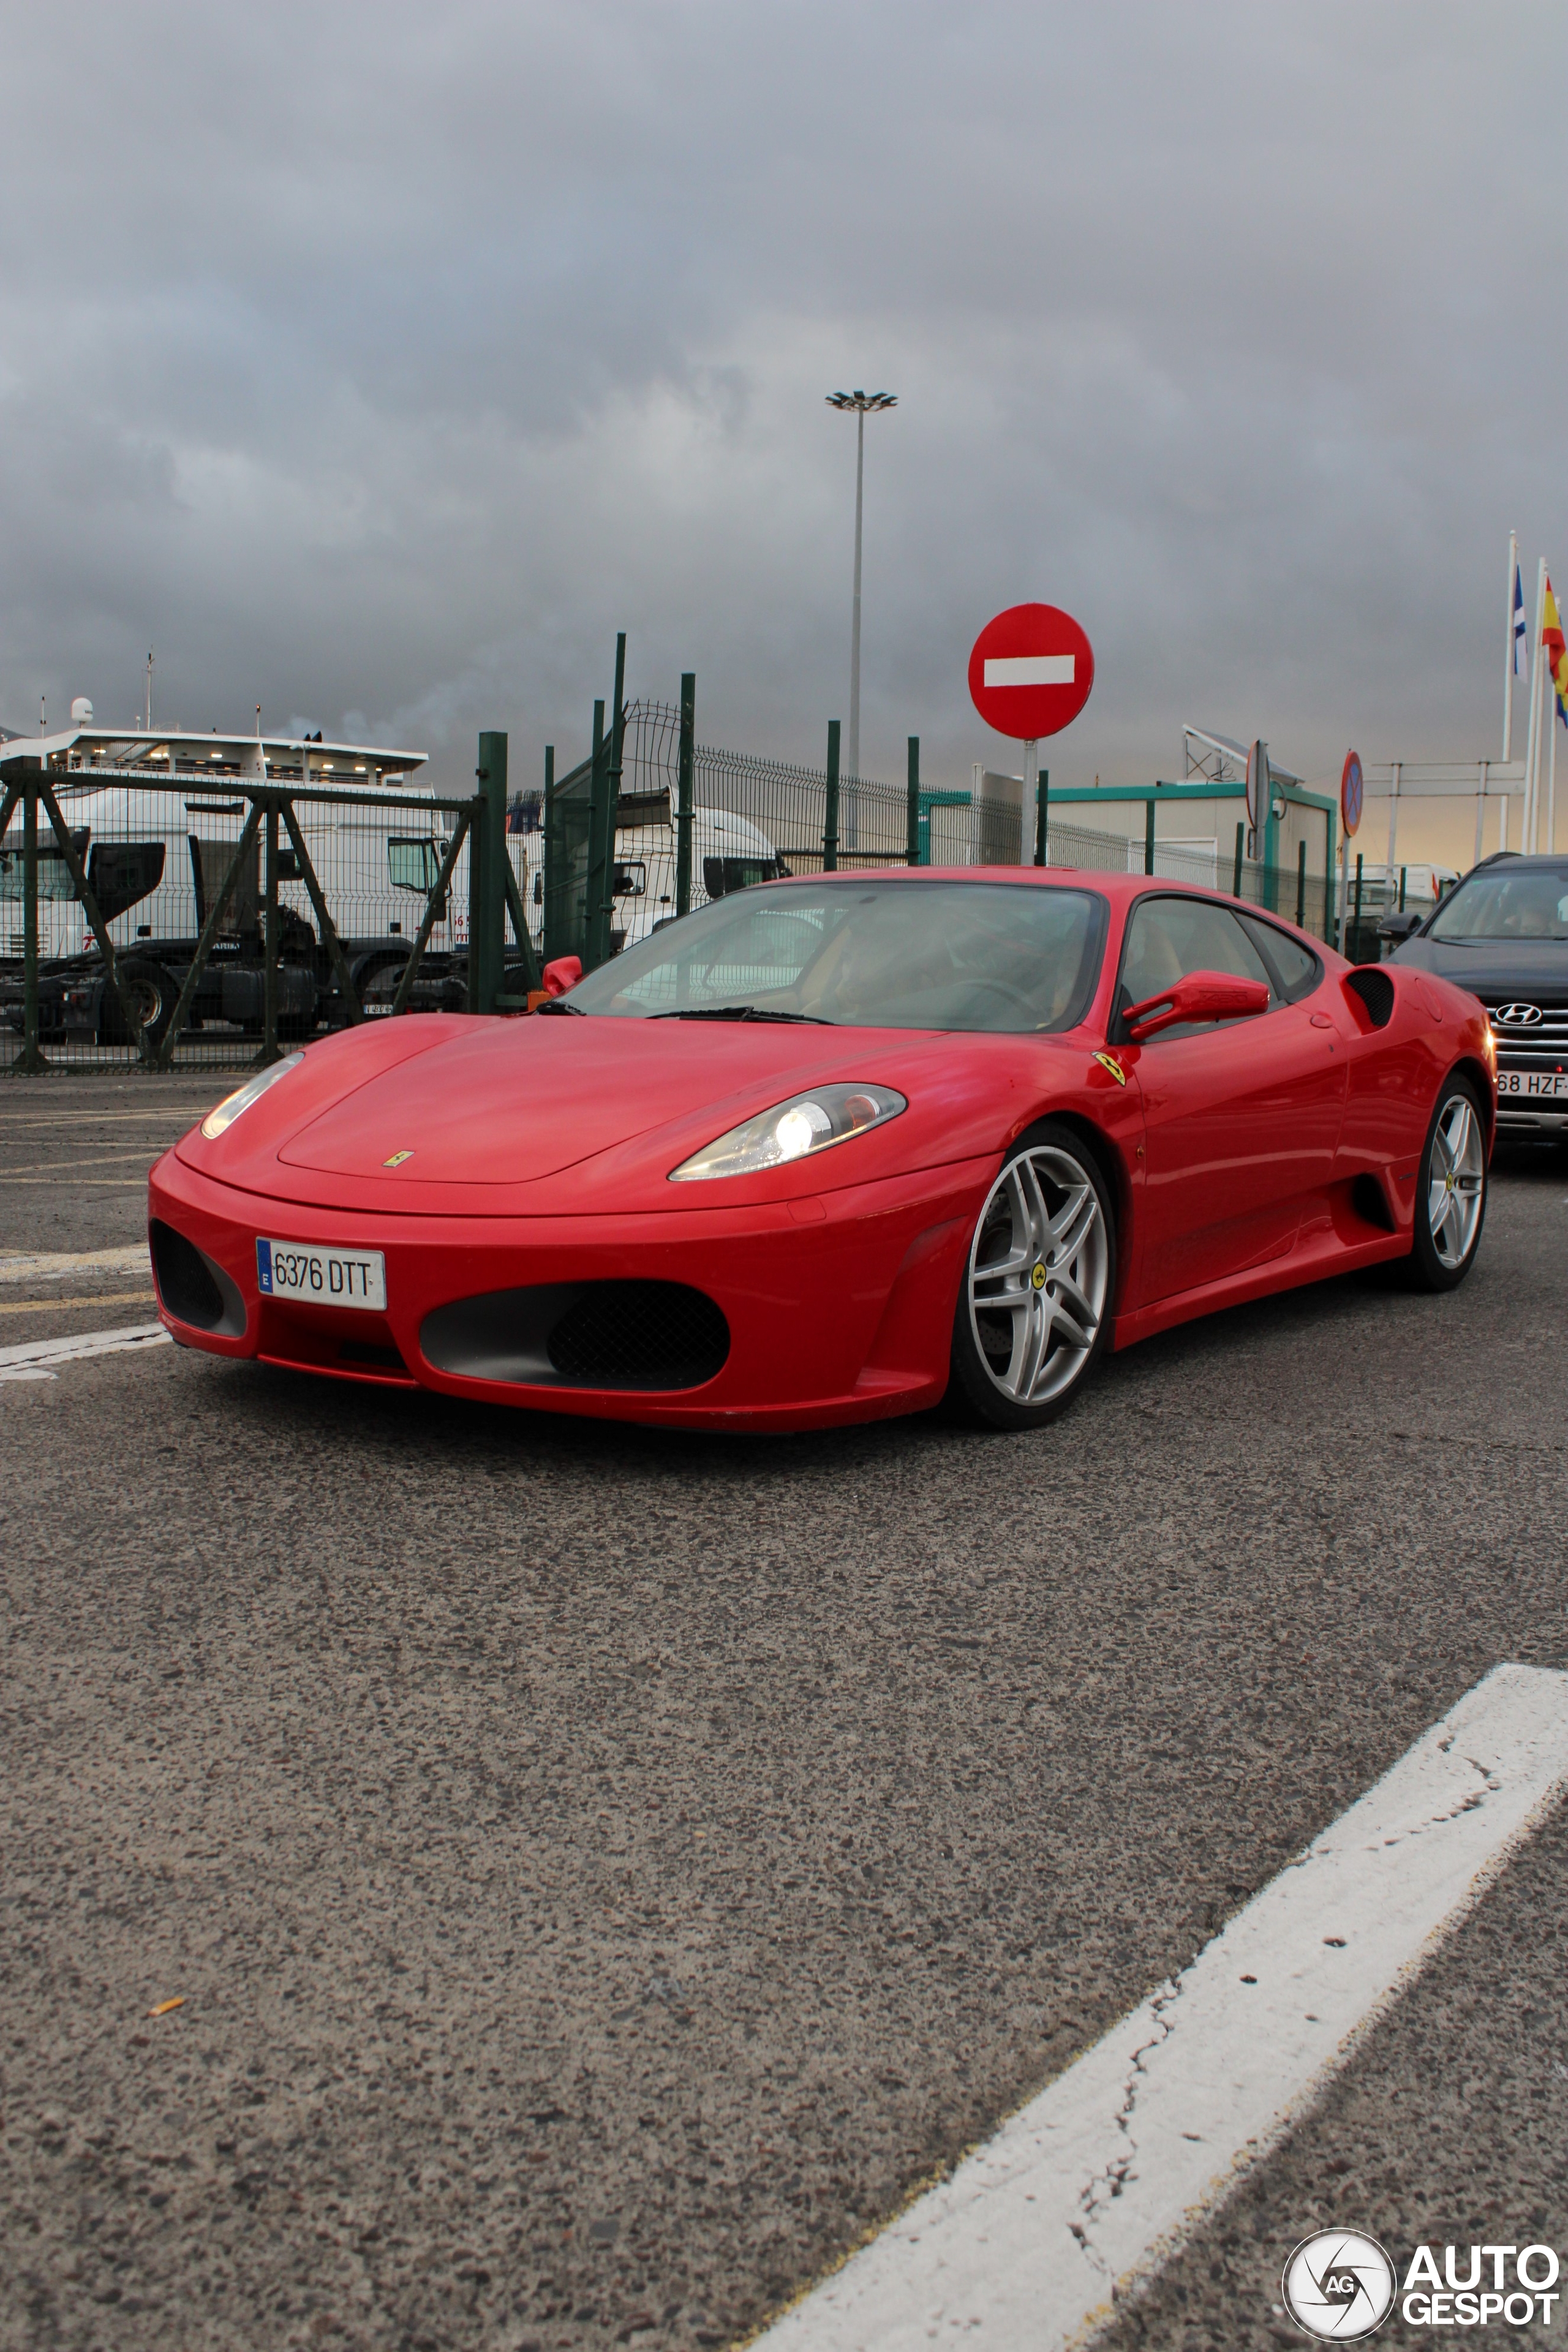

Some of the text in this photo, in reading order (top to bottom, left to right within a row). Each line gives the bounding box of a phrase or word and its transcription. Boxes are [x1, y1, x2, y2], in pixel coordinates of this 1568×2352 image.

[1528, 1076, 1566, 1095] HZF
[262, 1273, 270, 1286] E
[274, 1253, 371, 1296] 6376 DTT
